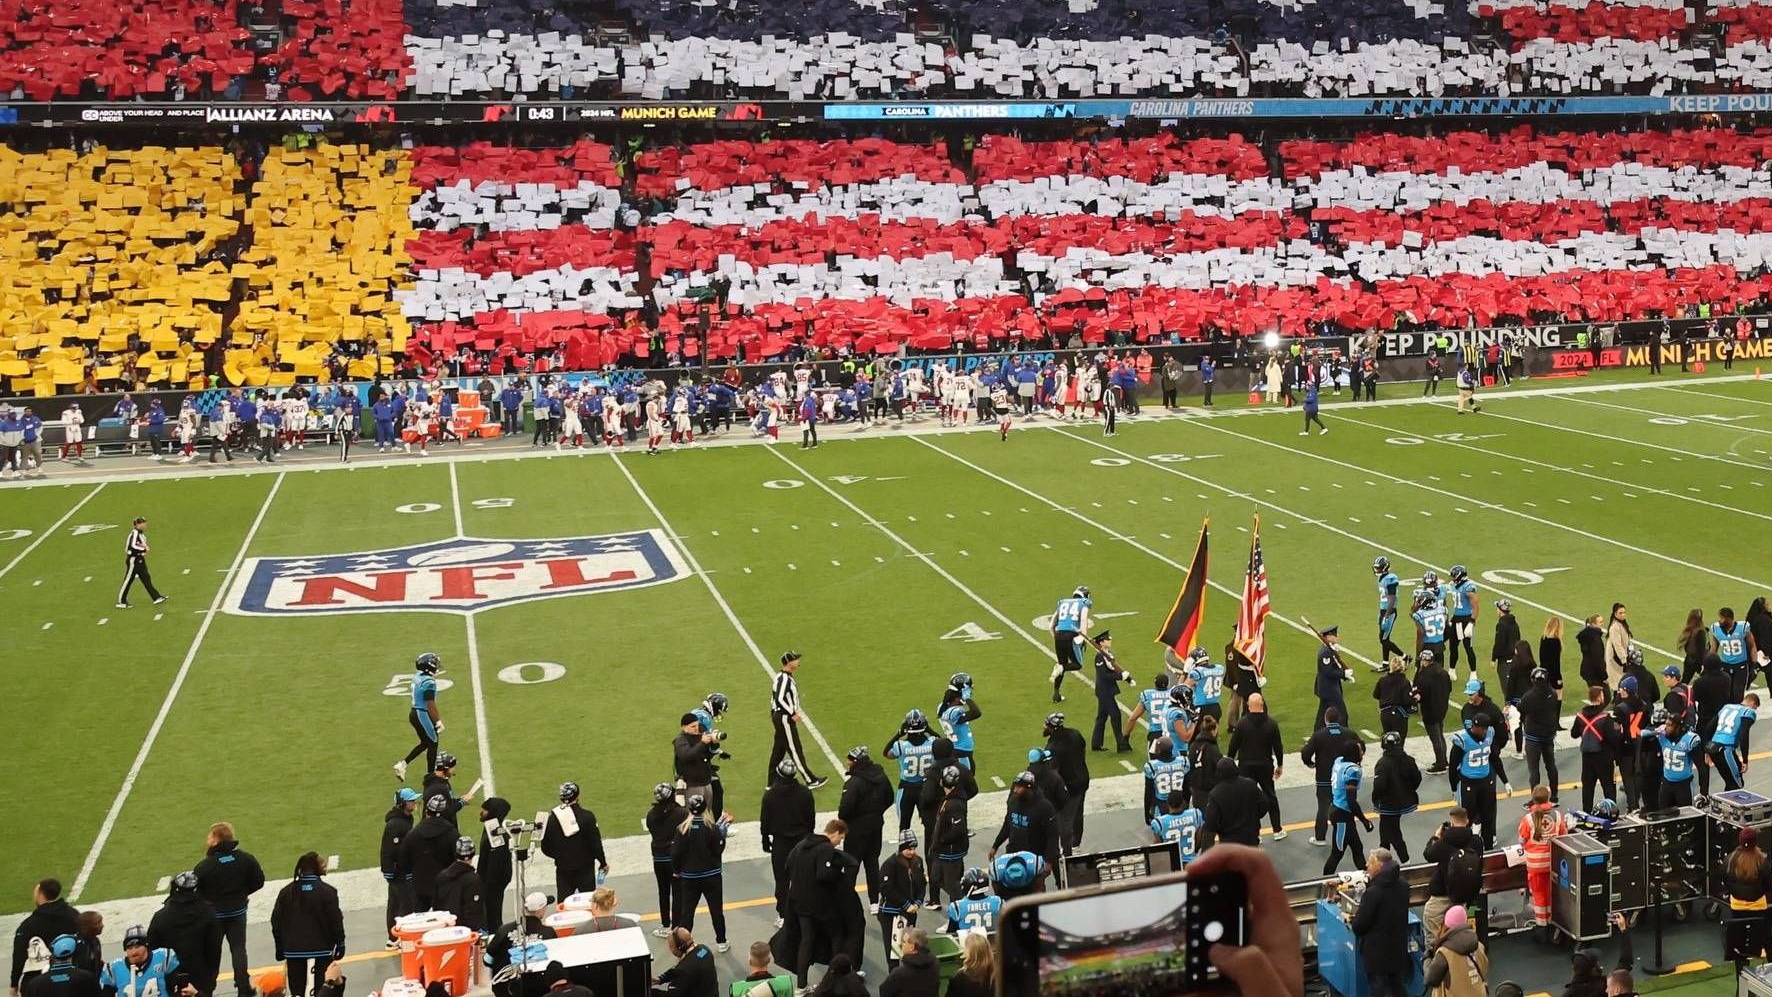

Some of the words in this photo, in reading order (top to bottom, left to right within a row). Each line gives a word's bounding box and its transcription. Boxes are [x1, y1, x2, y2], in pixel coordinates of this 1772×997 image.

[1129, 101, 1188, 116] CAROLINA
[1192, 100, 1255, 116] PANTHERS
[1669, 95, 1721, 111] KEEP
[209, 108, 277, 122] ALLIANZ
[280, 108, 334, 122] ARENA
[528, 108, 555, 120] 0:43
[580, 109, 599, 118] 2024
[600, 109, 616, 117] NFL
[620, 107, 675, 119] MUNICH
[677, 107, 717, 119] GAME
[884, 107, 927, 116] CAROLINA
[935, 104, 1009, 118] PANTHERS
[1350, 333, 1414, 356] KEP
[1423, 326, 1561, 355] POUNDNG
[1559, 353, 1589, 367] 2024
[955, 381, 966, 391] 72
[286, 557, 638, 607] NFL
[1058, 601, 1080, 621] 84
[1423, 614, 1446, 638] 53
[1203, 676, 1223, 699] 49
[1168, 815, 1194, 827] JACKSON
